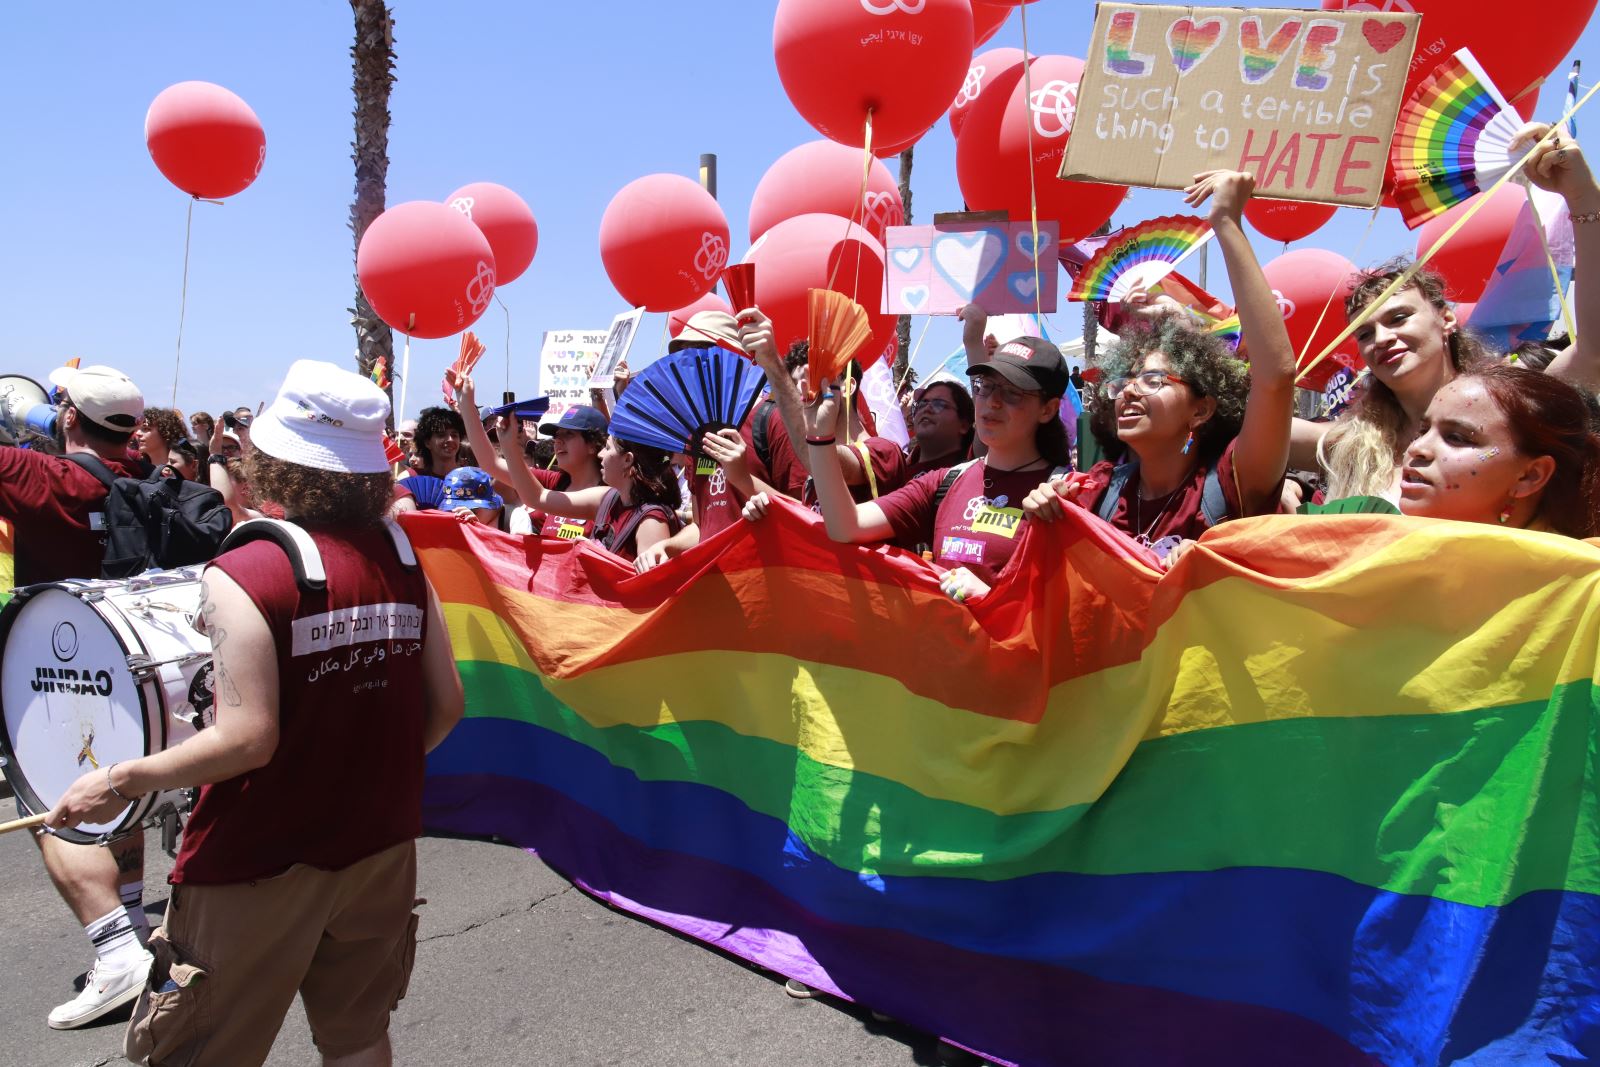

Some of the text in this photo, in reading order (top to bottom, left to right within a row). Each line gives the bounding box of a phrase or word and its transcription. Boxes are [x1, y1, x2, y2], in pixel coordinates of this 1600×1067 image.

[1346, 55, 1387, 96] is
[1200, 90, 1224, 114] a
[1240, 94, 1373, 128] terrible
[1095, 112, 1381, 196] thing to HATE
[1327, 373, 1347, 394] OUD
[976, 511, 1018, 530] צוות
[311, 620, 345, 641] מקום
[308, 656, 340, 682] مكان
[343, 647, 362, 671] كل
